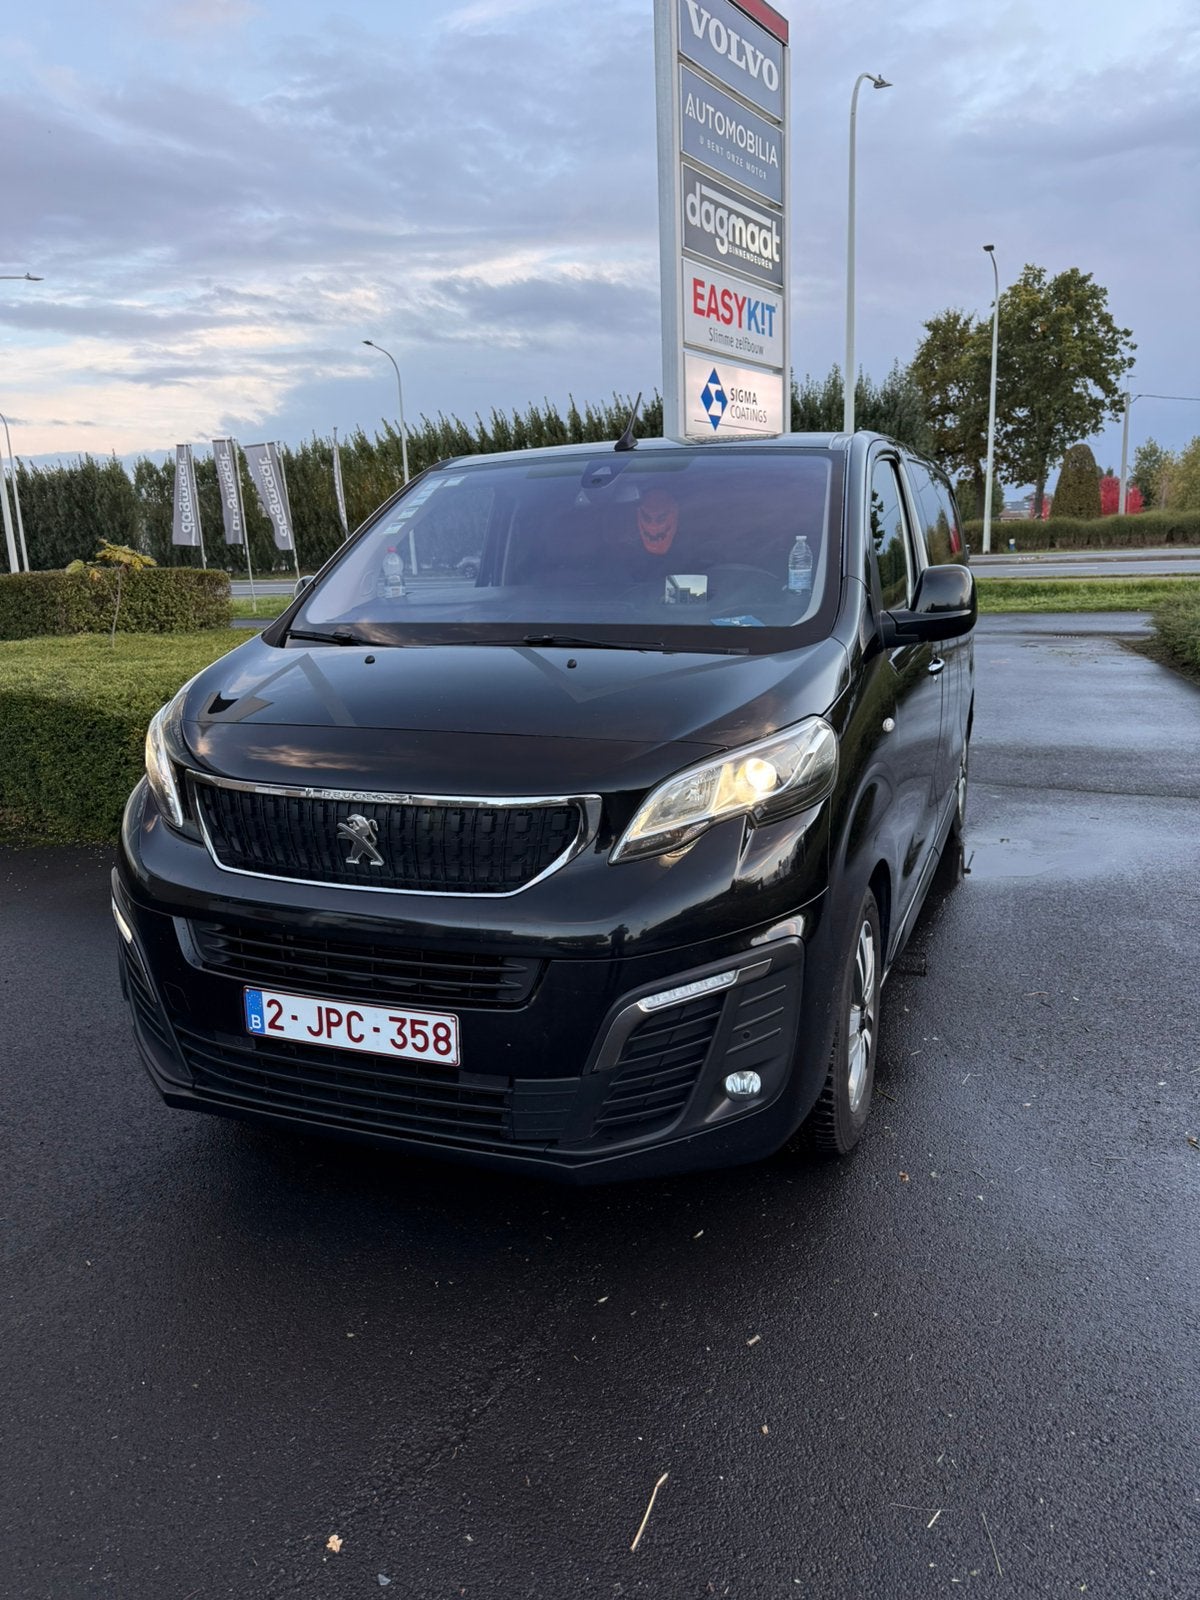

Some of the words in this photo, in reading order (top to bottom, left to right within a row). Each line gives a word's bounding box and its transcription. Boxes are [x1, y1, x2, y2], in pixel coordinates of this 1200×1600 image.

[686, 0, 778, 92] VOLVO
[685, 93, 778, 168] AUTOMOBILIA
[727, 150, 743, 167] ONZE
[686, 181, 780, 263] dagmaat
[709, 327, 734, 348] Slimme
[730, 387, 758, 406] SIGMA
[730, 404, 768, 424] COATINGS
[251, 1014, 261, 1029] B
[266, 998, 453, 1056] 2-JPC-358
